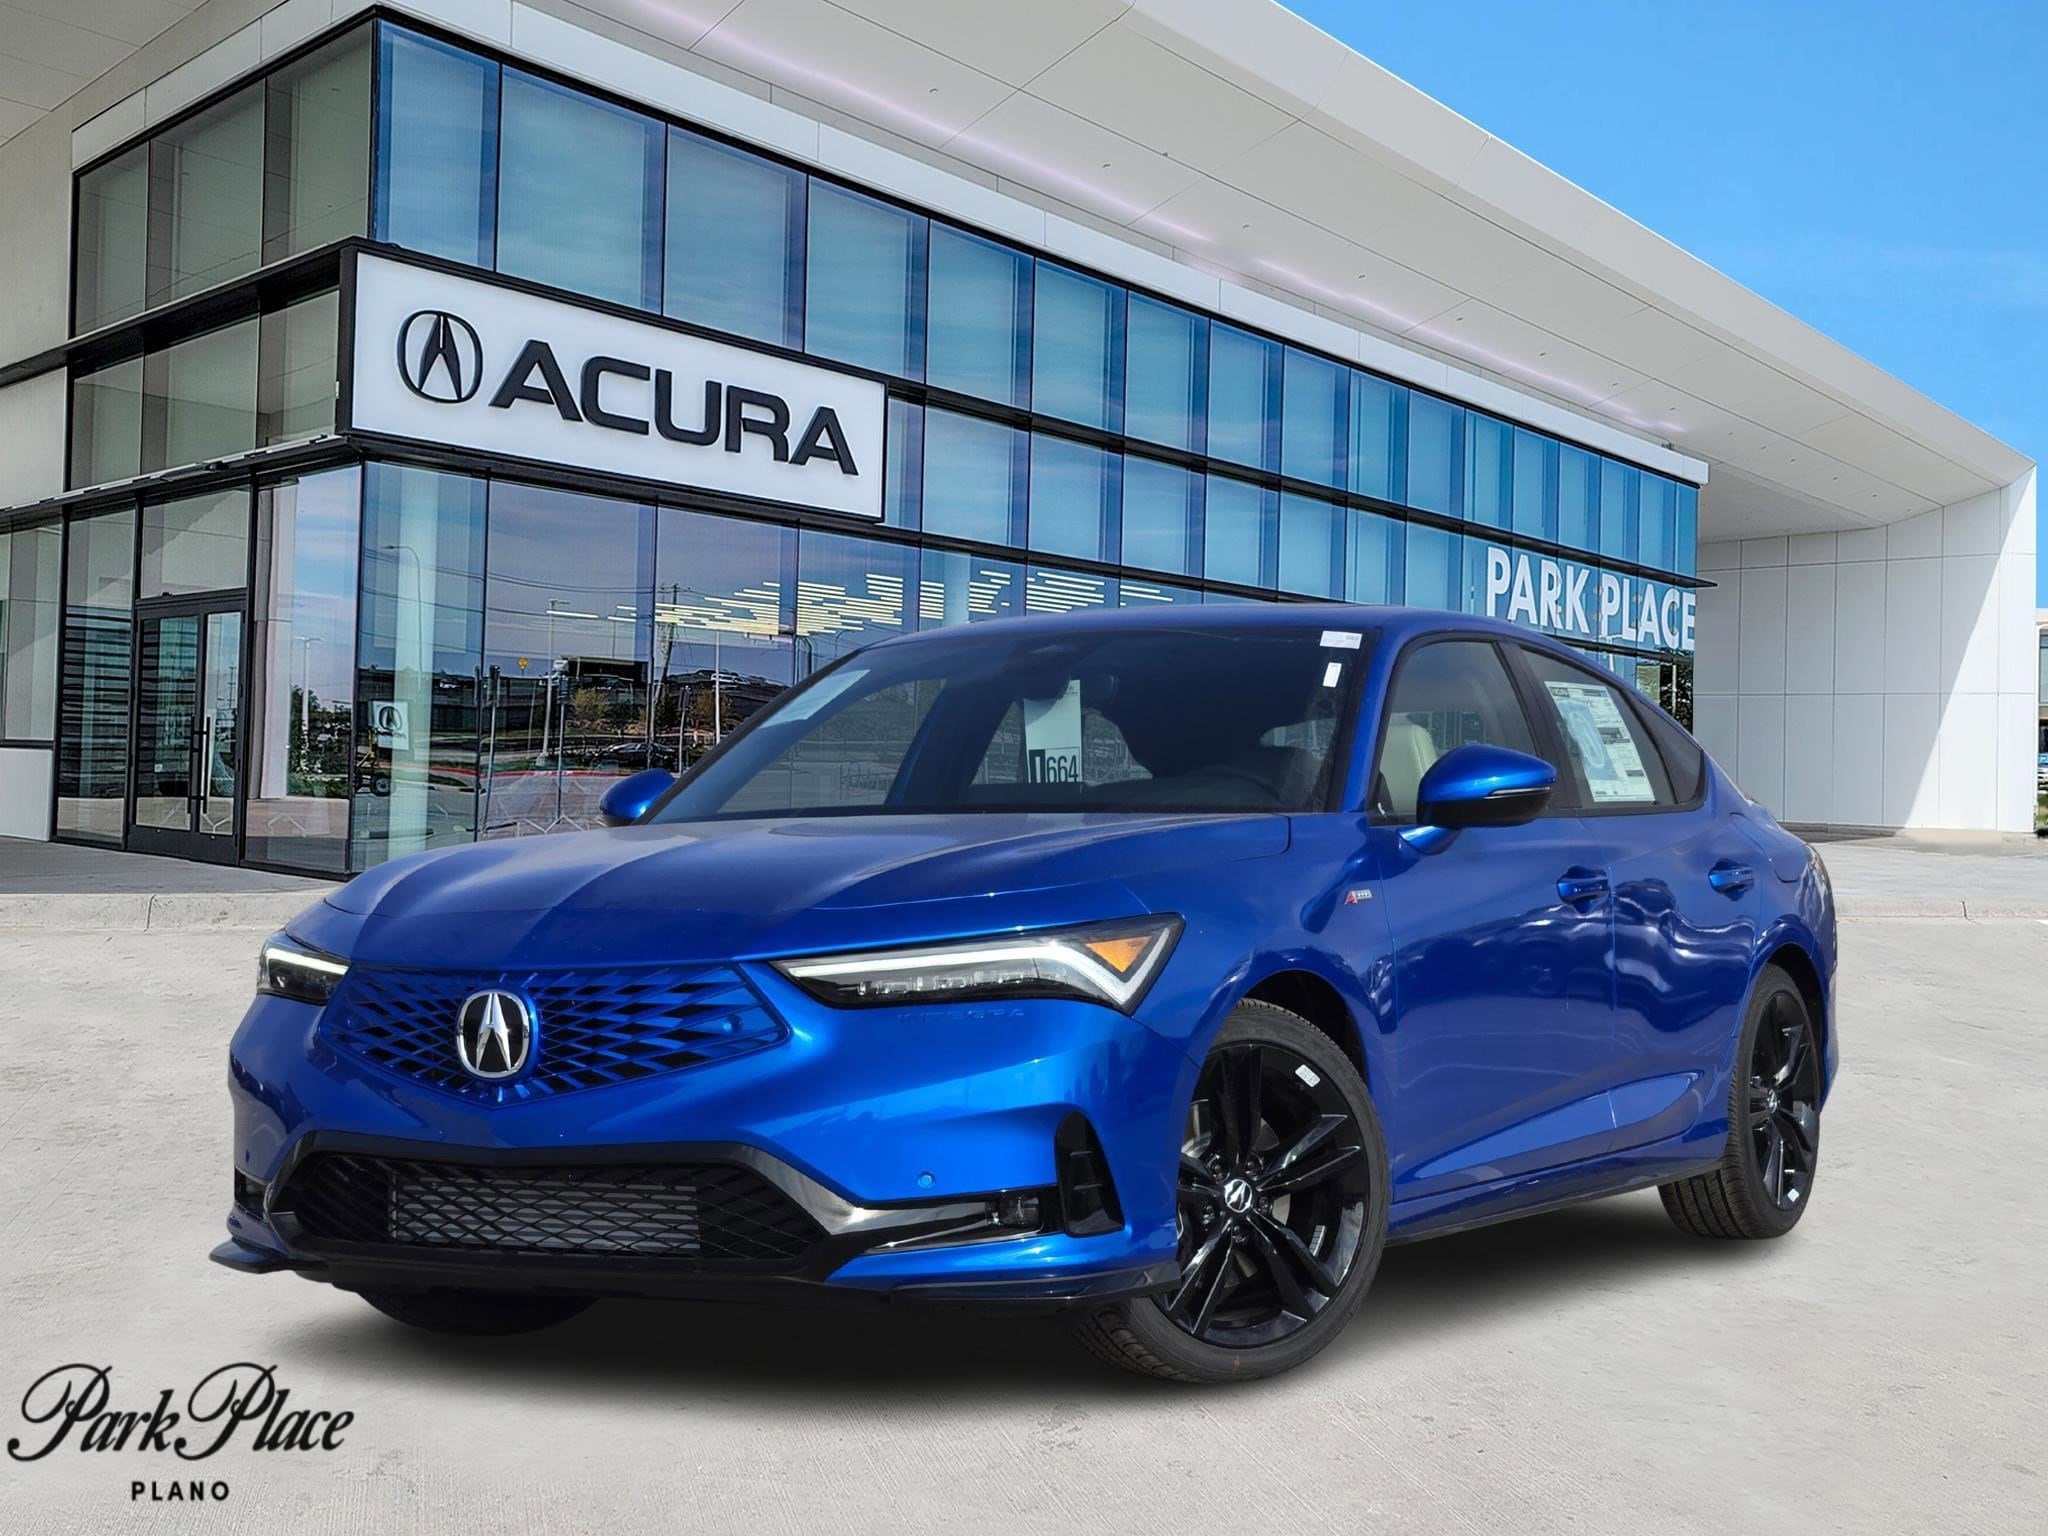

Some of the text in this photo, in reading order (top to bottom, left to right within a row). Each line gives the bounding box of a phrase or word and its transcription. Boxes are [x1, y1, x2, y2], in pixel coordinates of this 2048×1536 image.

[489, 339, 858, 476] ACURA
[1486, 547, 1697, 651] PARK PLACE
